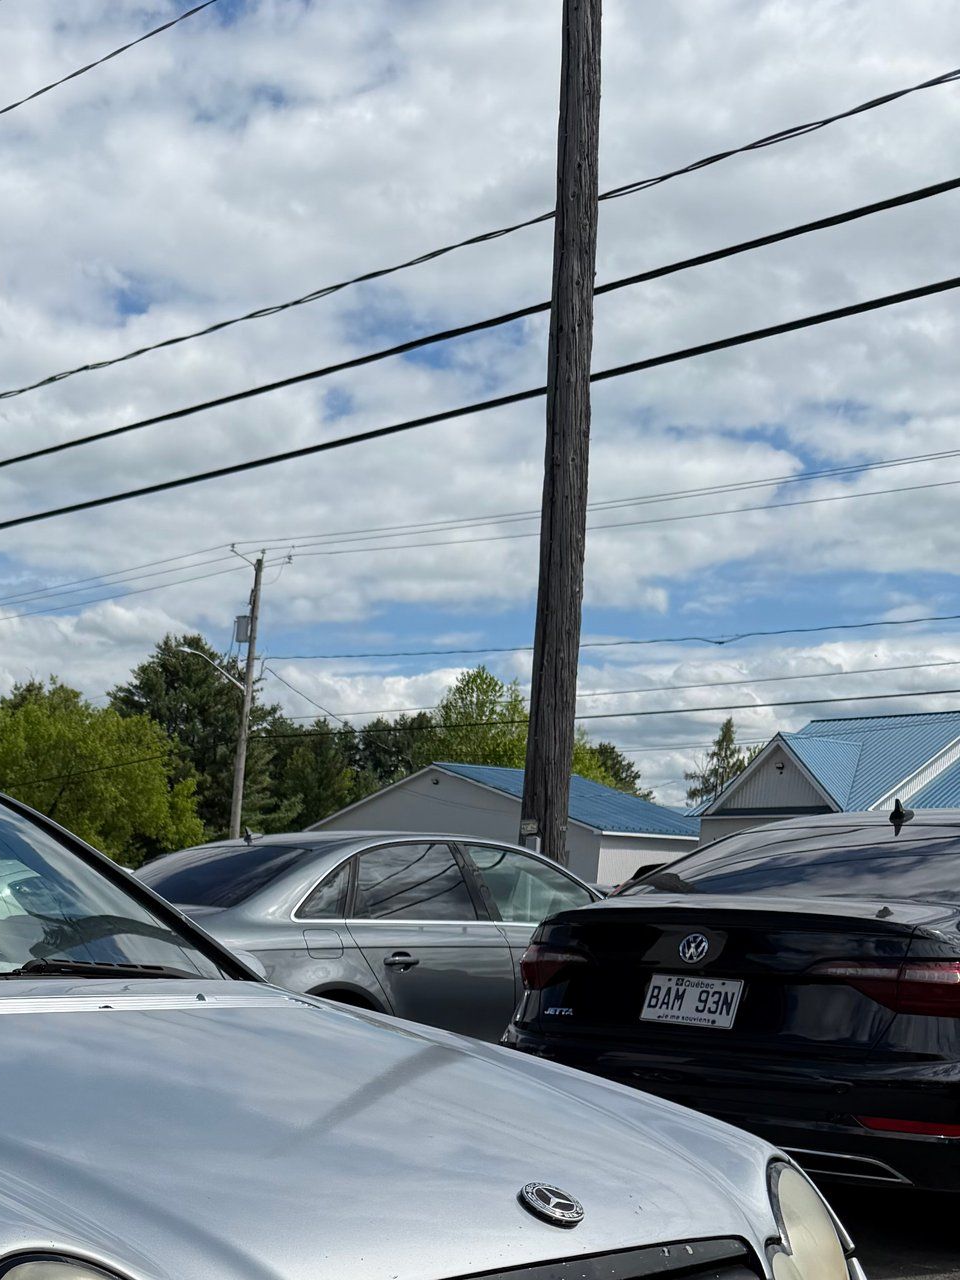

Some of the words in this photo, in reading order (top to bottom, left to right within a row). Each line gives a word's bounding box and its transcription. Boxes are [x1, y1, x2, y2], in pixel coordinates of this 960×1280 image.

[684, 979, 715, 990] Québec
[647, 985, 687, 1012] BAM
[695, 989, 736, 1017] 93N
[543, 1007, 574, 1016] JETTA
[681, 1015, 711, 1025] souviens
